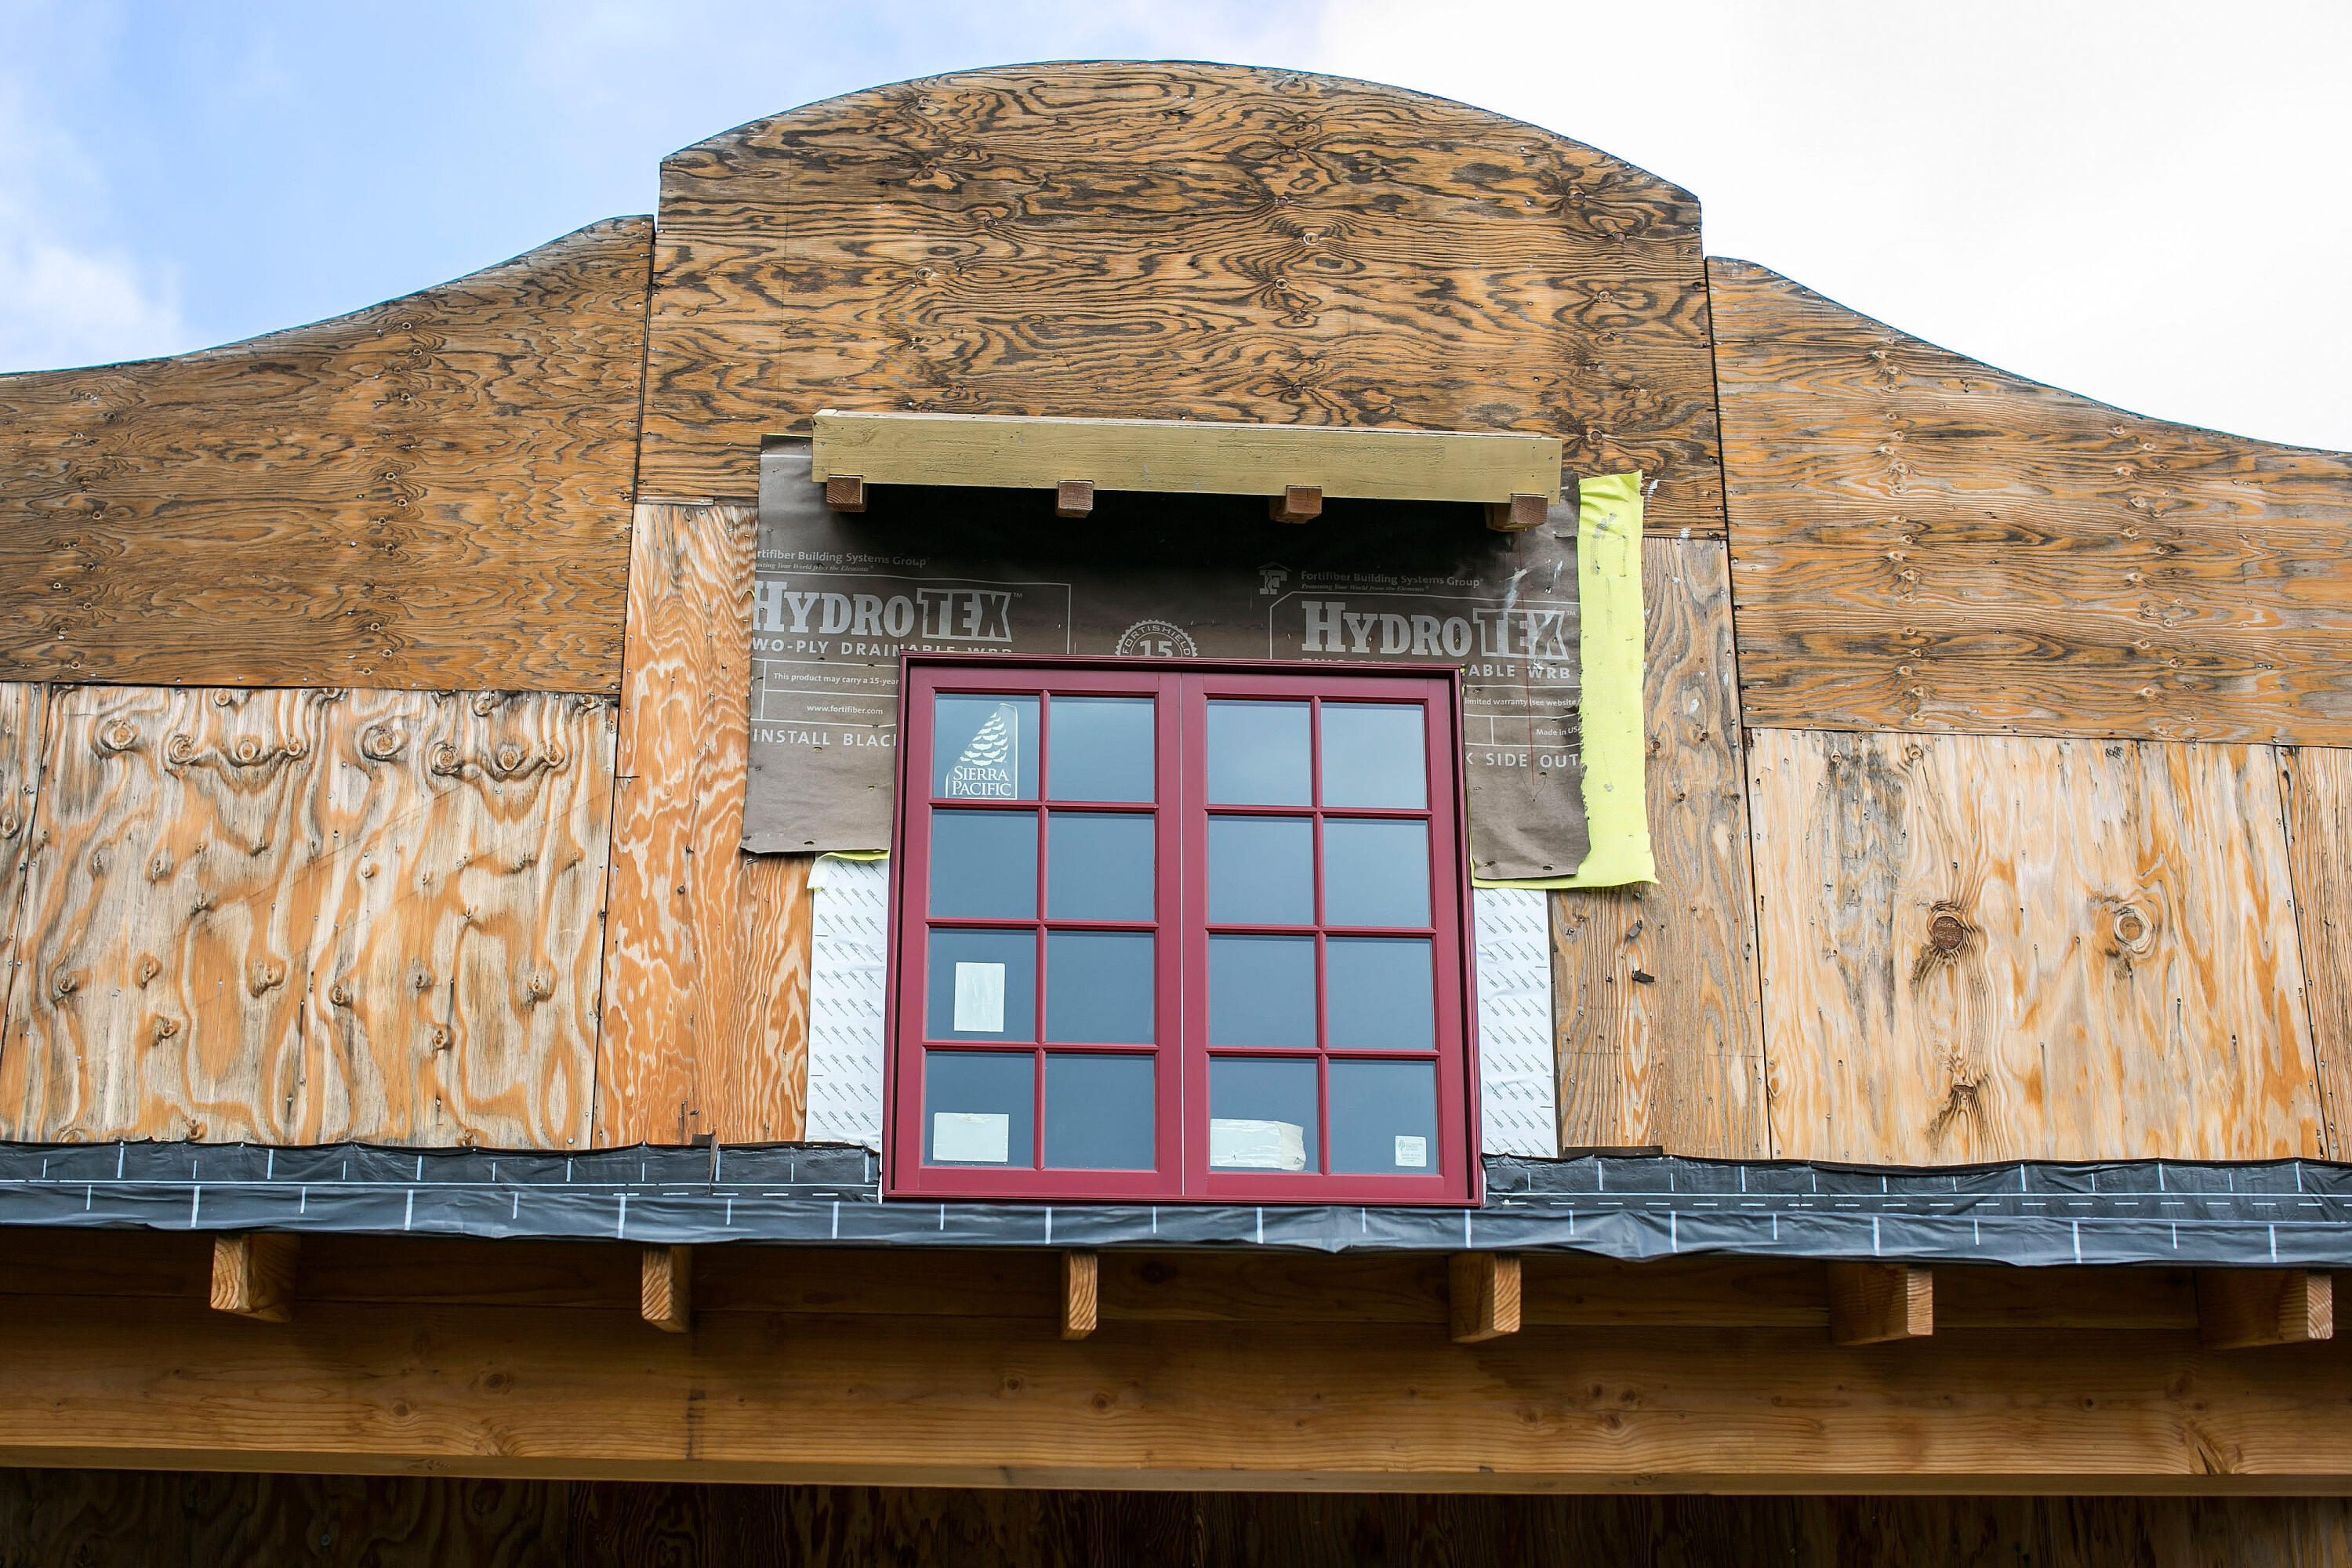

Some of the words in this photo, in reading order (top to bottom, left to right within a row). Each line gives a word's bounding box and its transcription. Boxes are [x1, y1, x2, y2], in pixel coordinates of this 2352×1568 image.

[798, 551, 843, 564] Building
[847, 553, 891, 564] Systems
[892, 556, 927, 568] Group
[1301, 571, 1350, 581] Fortifiber
[1353, 573, 1398, 585] Building
[1401, 575, 1444, 585] Systems
[1446, 576, 1479, 589] Group
[1122, 625, 1191, 656] FORTISHIELD
[1139, 640, 1174, 658] 15
[791, 673, 822, 682] product
[842, 677, 861, 685] carry
[869, 677, 899, 687] 15-year
[1463, 664, 1515, 677] ABLE
[1528, 666, 1570, 679] WRB
[806, 705, 884, 715] www.fortifiber.com
[1465, 697, 1491, 706] limited
[1546, 698, 1577, 706] website
[753, 728, 830, 746] INSTALL
[1536, 728, 1558, 736] Made
[1486, 752, 1527, 768] SIDE
[1539, 753, 1579, 768] OUT
[953, 765, 1010, 782] SIERRA
[952, 780, 1011, 797] PACIFIC
